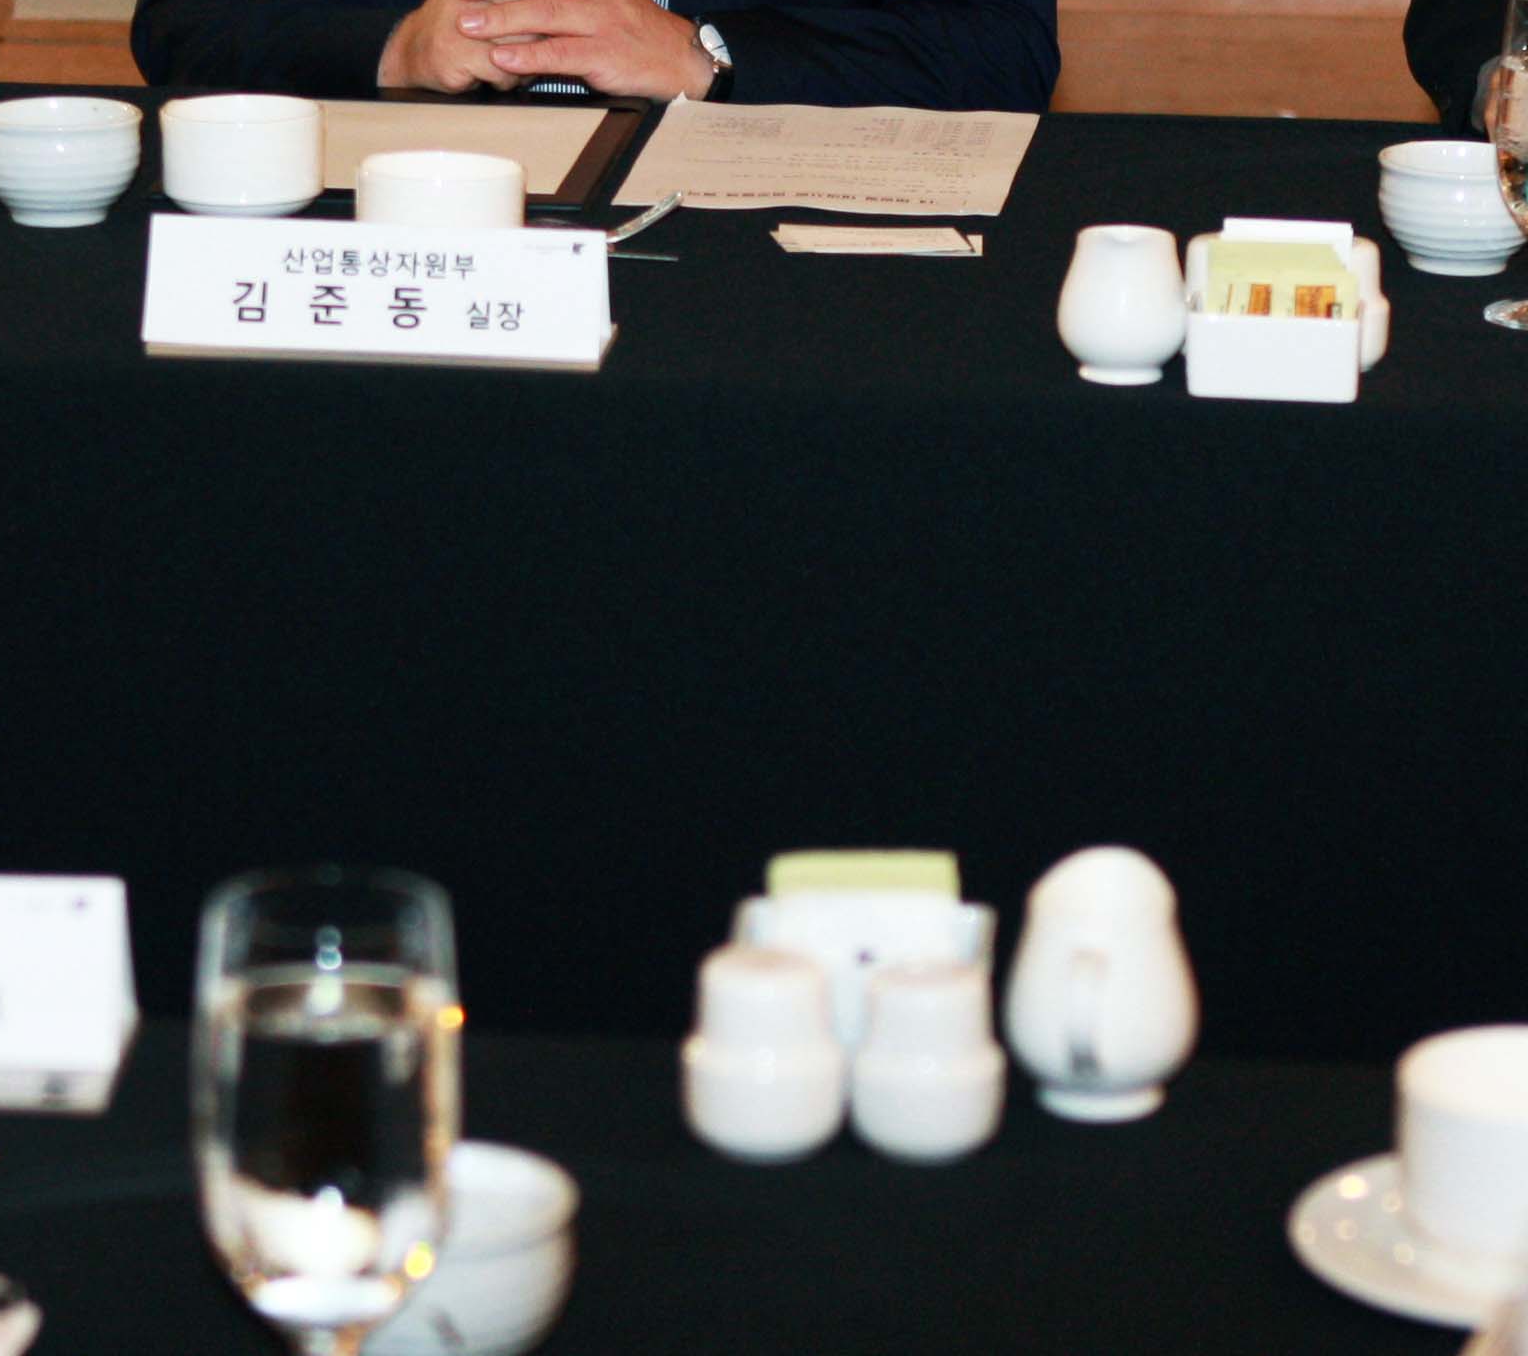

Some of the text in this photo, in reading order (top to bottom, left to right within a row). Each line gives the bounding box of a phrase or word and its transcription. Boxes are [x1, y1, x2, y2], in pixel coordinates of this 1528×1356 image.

[283, 248, 476, 281] 산업통상자원부
[233, 280, 525, 332] 김 준 동 실장
